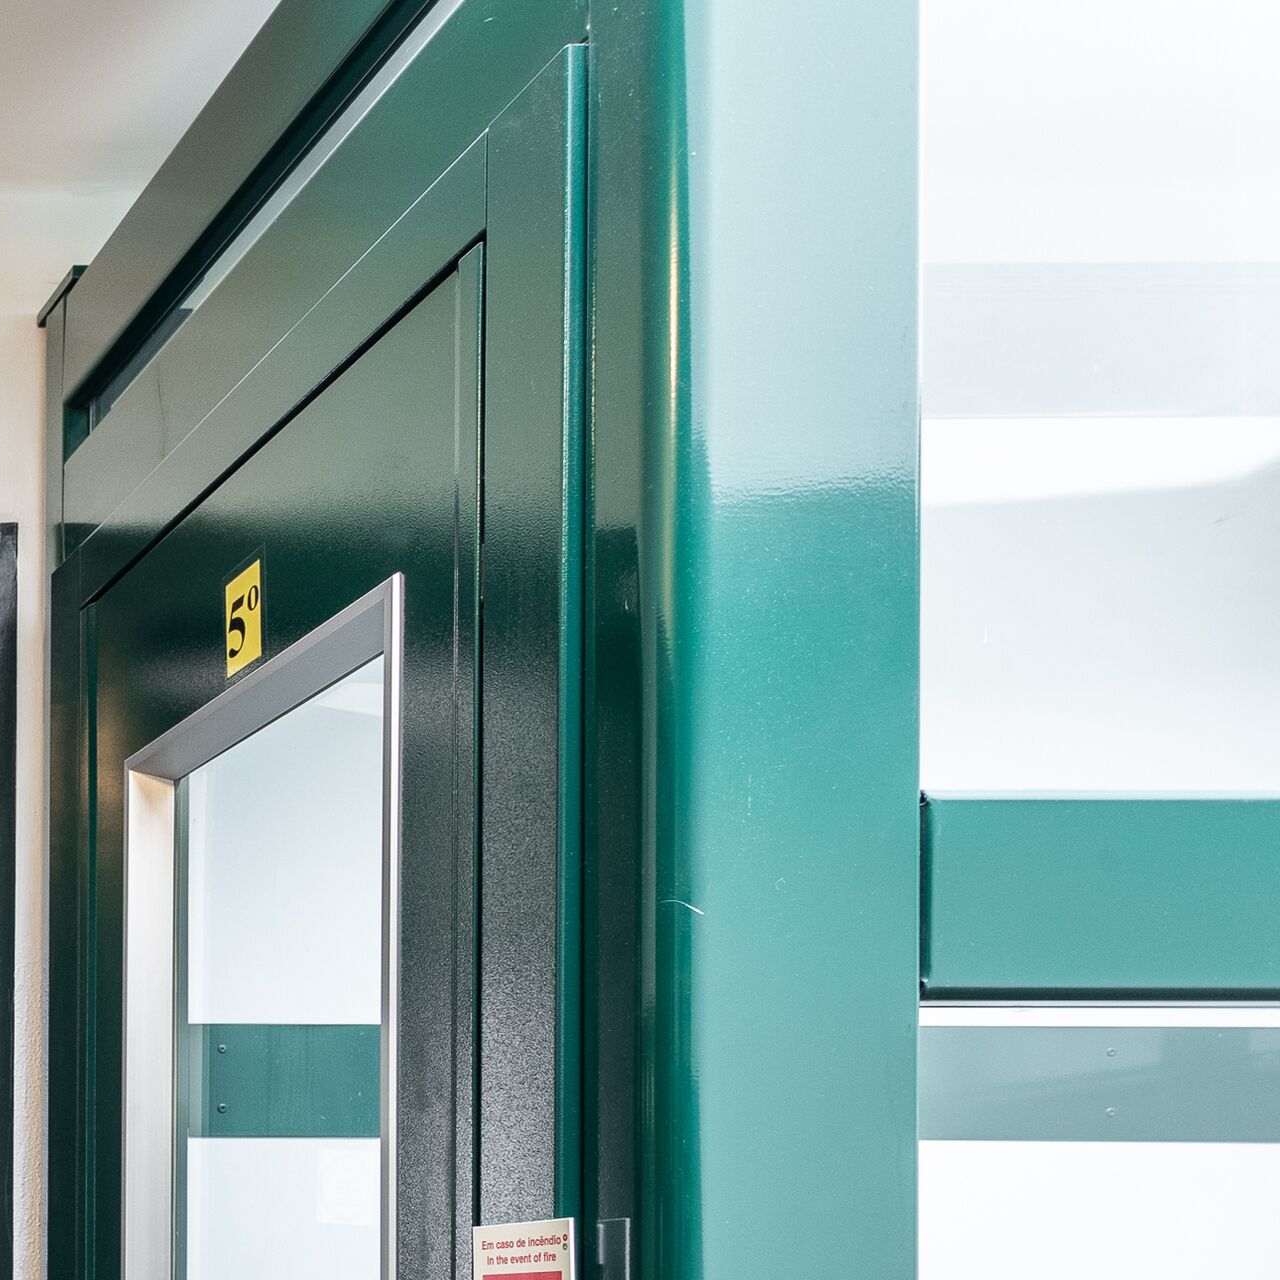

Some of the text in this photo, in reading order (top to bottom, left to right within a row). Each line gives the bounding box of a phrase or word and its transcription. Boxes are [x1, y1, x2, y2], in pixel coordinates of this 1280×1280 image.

[481, 1235, 561, 1250] Em caso de incêndio
[487, 1252, 556, 1265] In the event of fire
